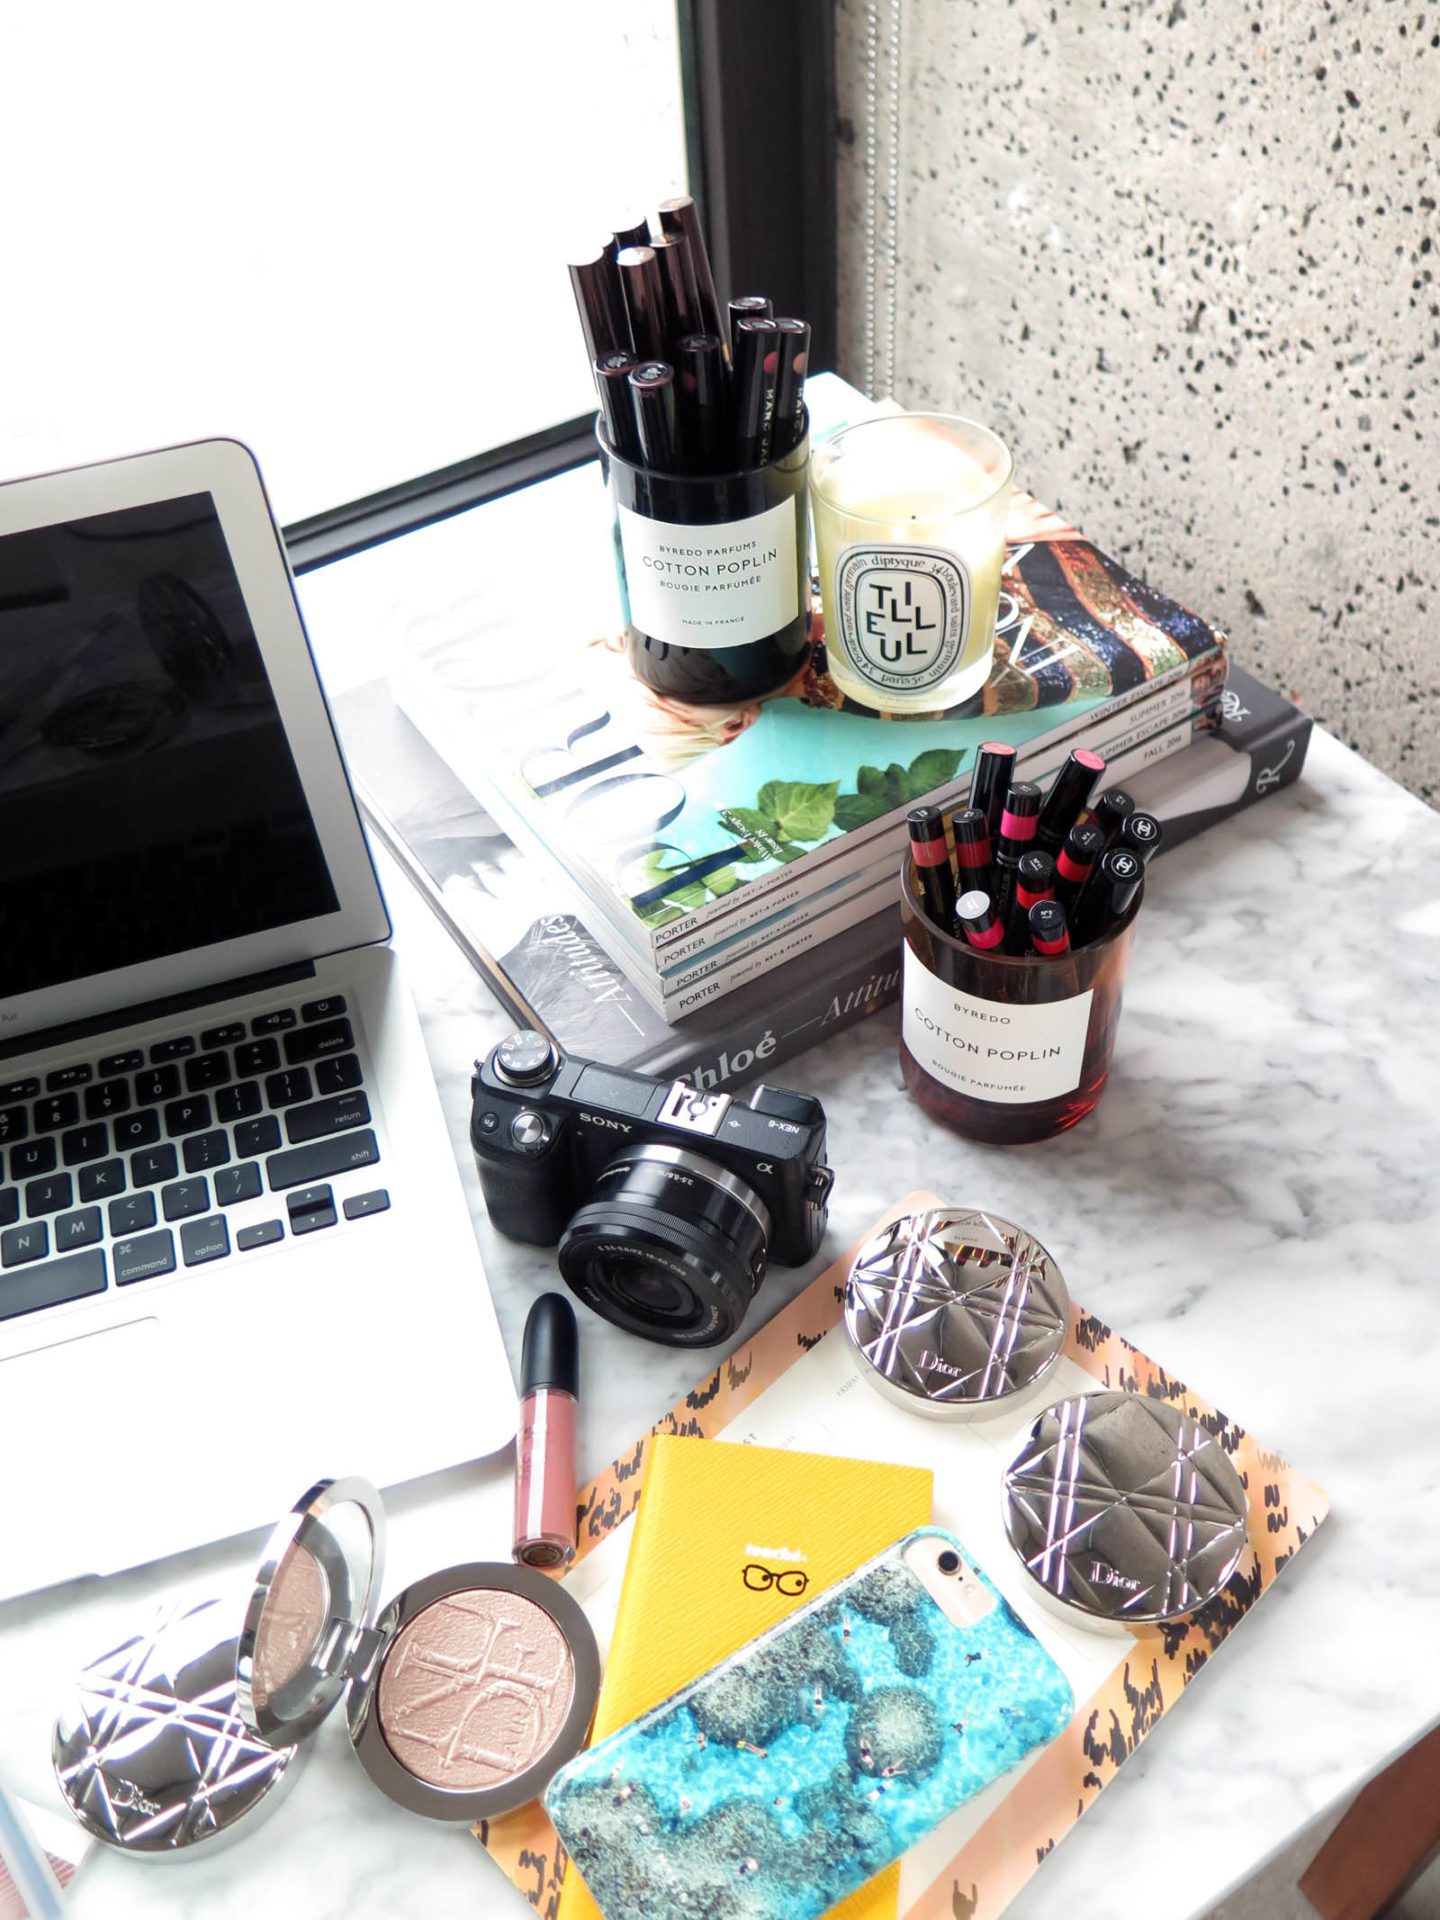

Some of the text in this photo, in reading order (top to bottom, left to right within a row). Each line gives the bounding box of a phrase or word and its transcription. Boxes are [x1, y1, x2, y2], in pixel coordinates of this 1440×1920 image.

[658, 541, 757, 557] BYREDO PARFUMS
[642, 548, 777, 576] COTTON POPLIN
[871, 555, 925, 568] diptyque
[660, 575, 761, 592] BOUGIE PARFUMÉE
[1100, 736, 1134, 758] UMMER
[1144, 746, 1163, 760] FALL
[655, 917, 698, 943] PORTER
[540, 915, 633, 1003] Attitudes
[664, 938, 706, 964] PORTER
[676, 960, 718, 987] PORTER
[679, 982, 720, 1009] PORTER
[954, 1003, 1011, 1024] BYREDO
[915, 1007, 1061, 1061] COTTON POPLIN
[318, 1037, 344, 1049] delete
[932, 1059, 1026, 1092] BOUGIE PARFUMÉE
[182, 1108, 192, 1119] P
[334, 1111, 361, 1124] return
[579, 1112, 633, 1133] SONY
[27, 1151, 38, 1162] U
[351, 1150, 370, 1162] shift
[149, 1160, 158, 1170] L
[96, 1173, 107, 1184] K
[45, 1188, 52, 1199] J
[71, 1221, 85, 1234] M
[18, 1236, 30, 1249] N
[194, 1242, 223, 1257] option
[121, 1257, 167, 1277] command
[916, 1350, 962, 1378] Dior
[1088, 1560, 1141, 1591] Dior
